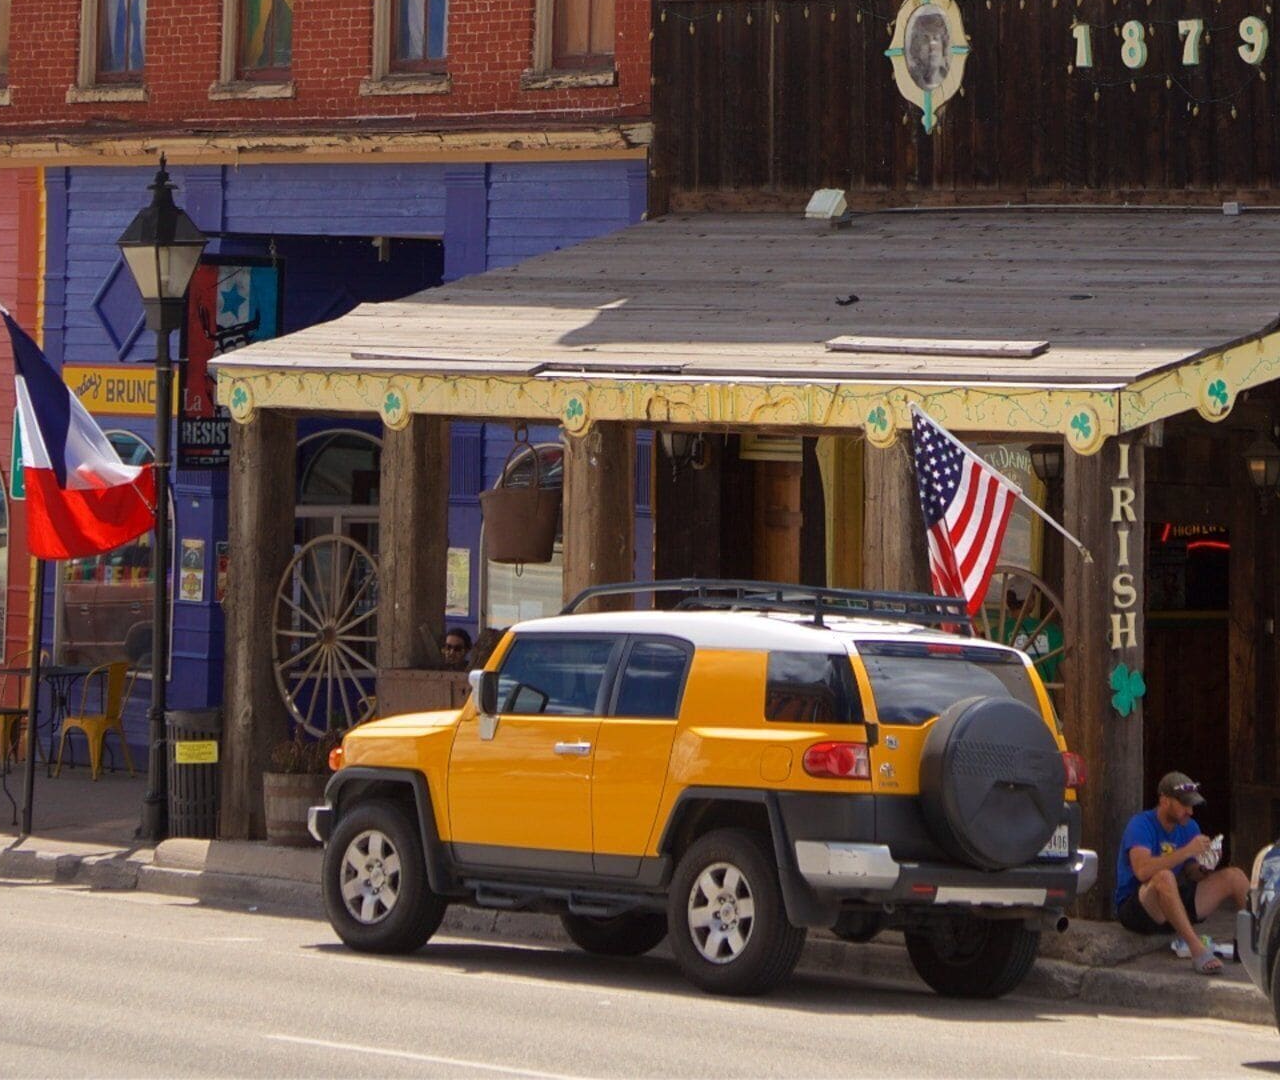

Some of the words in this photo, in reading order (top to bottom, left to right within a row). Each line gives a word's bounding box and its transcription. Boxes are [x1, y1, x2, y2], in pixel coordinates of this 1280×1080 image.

[106, 378, 156, 404] BRUNC
[183, 388, 202, 411] La
[1110, 443, 1138, 650] IRISH
